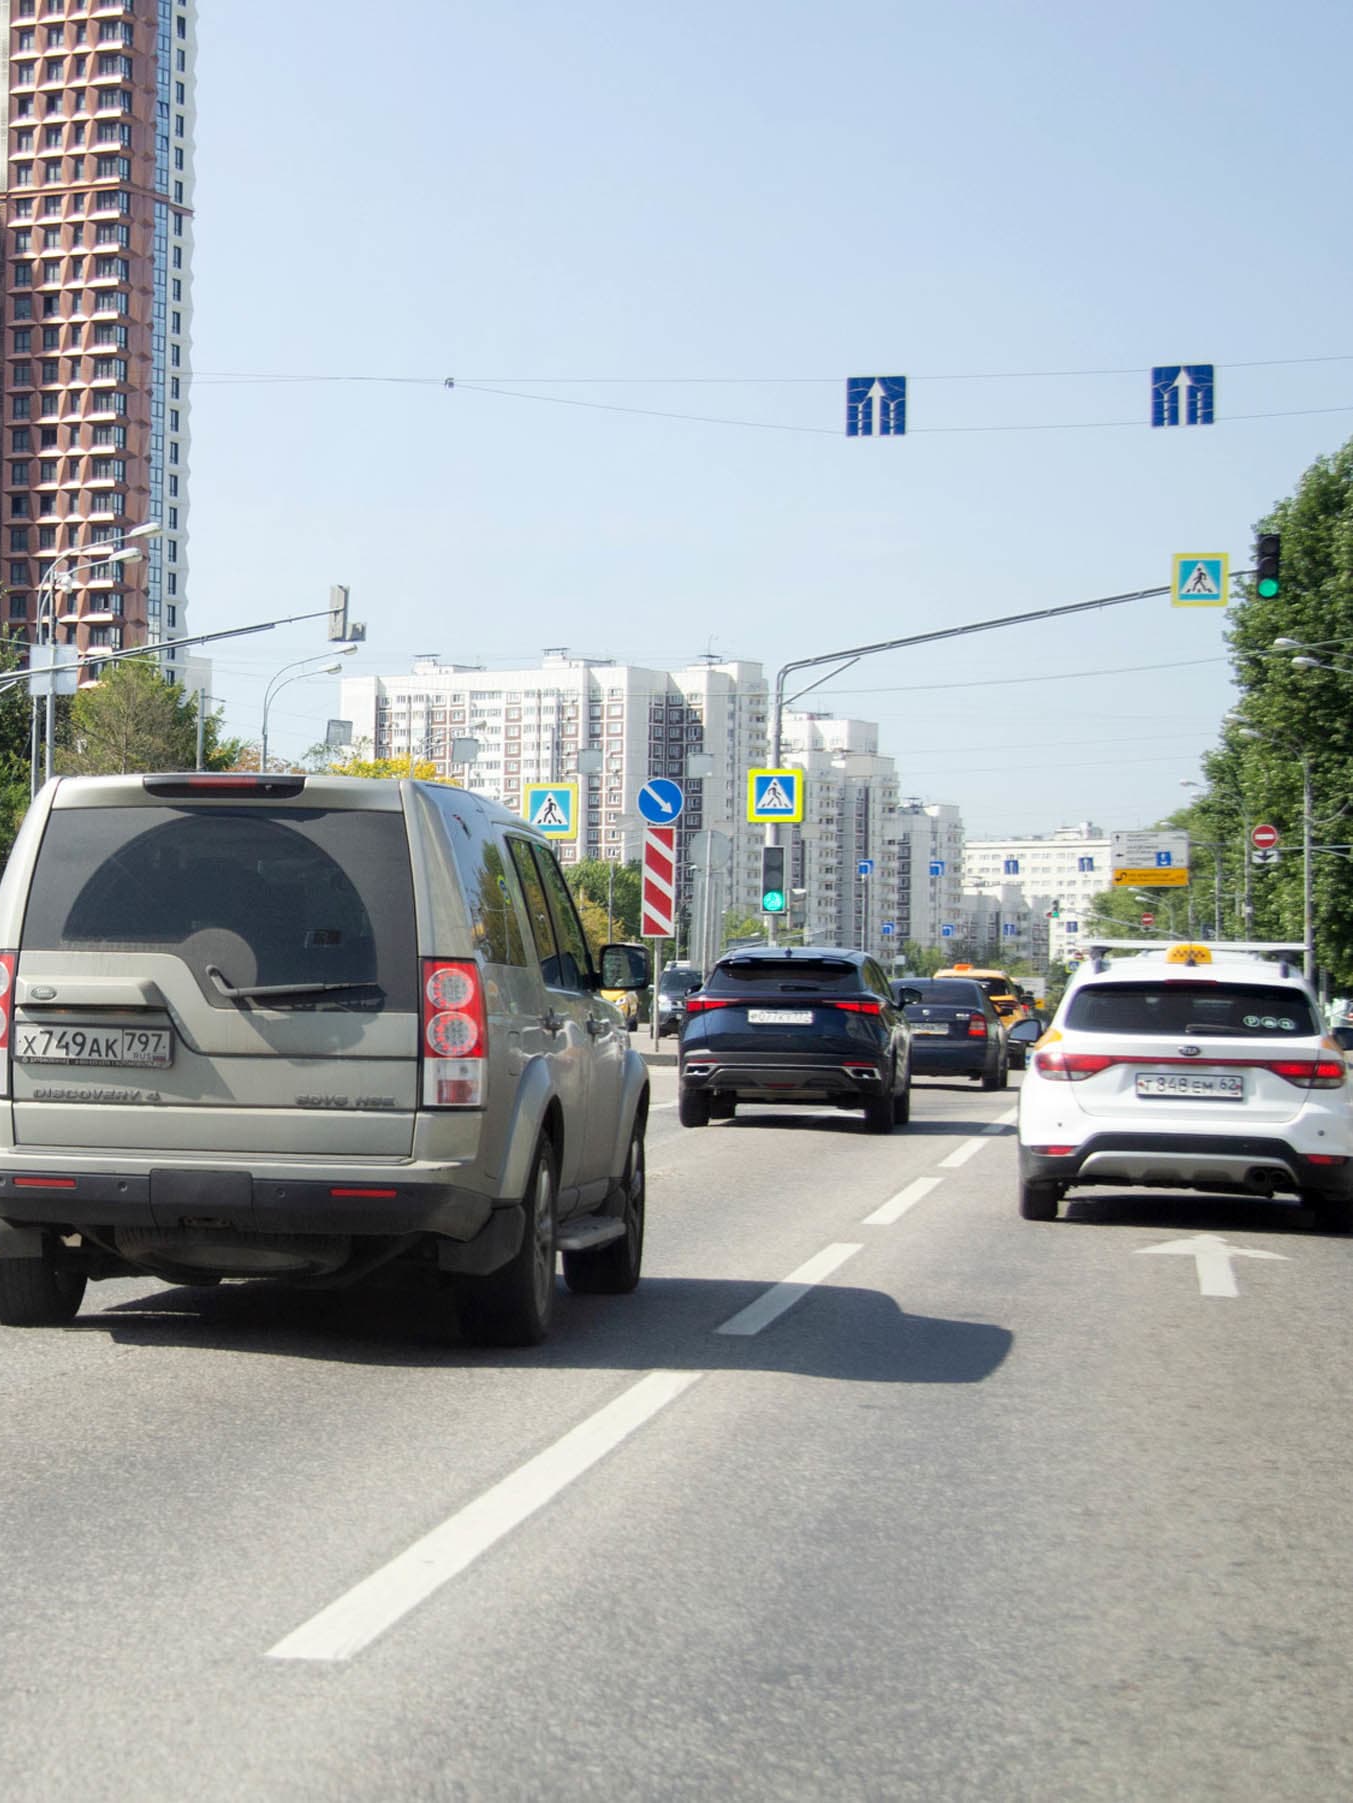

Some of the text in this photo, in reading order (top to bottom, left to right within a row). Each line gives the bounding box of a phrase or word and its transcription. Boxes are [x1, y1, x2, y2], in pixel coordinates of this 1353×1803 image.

[23, 1030, 163, 1058] Х749АК 797
[33, 1088, 141, 1101] DISCOVERY
